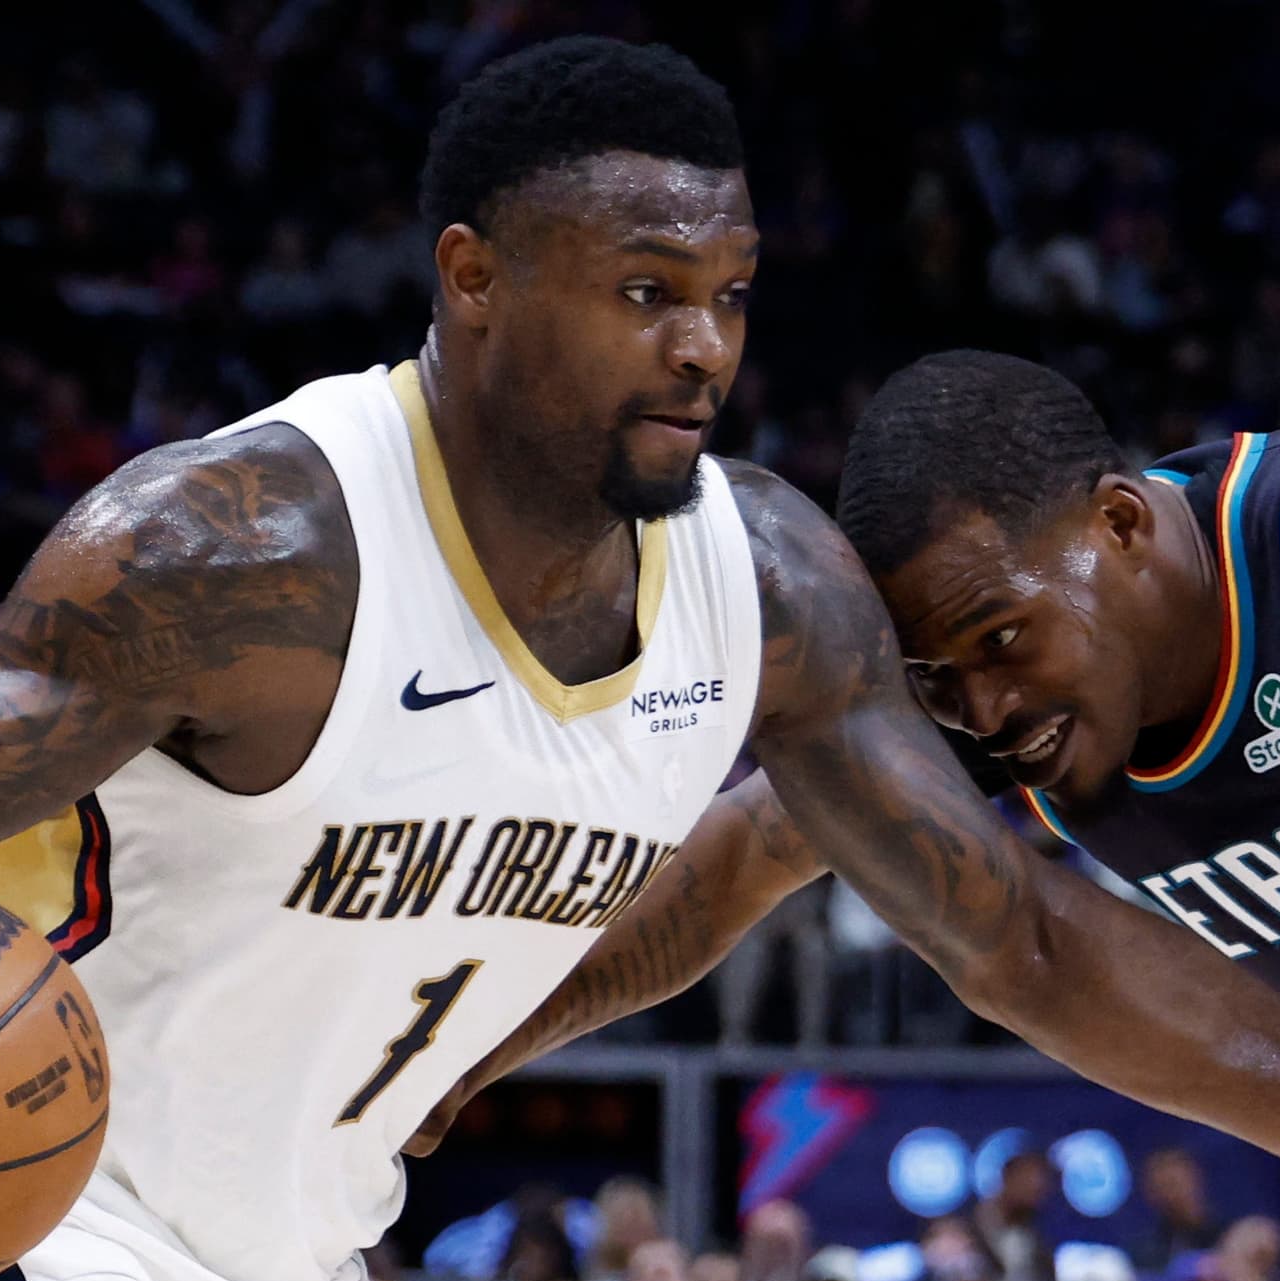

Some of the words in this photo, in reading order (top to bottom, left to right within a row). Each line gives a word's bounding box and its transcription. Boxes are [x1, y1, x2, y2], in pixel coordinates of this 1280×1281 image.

[631, 680, 724, 717] NEWAGE
[650, 713, 698, 733] GRILLS
[280, 815, 477, 921] NEW
[453, 816, 682, 929] ORLEAN
[331, 959, 485, 1129] 1
